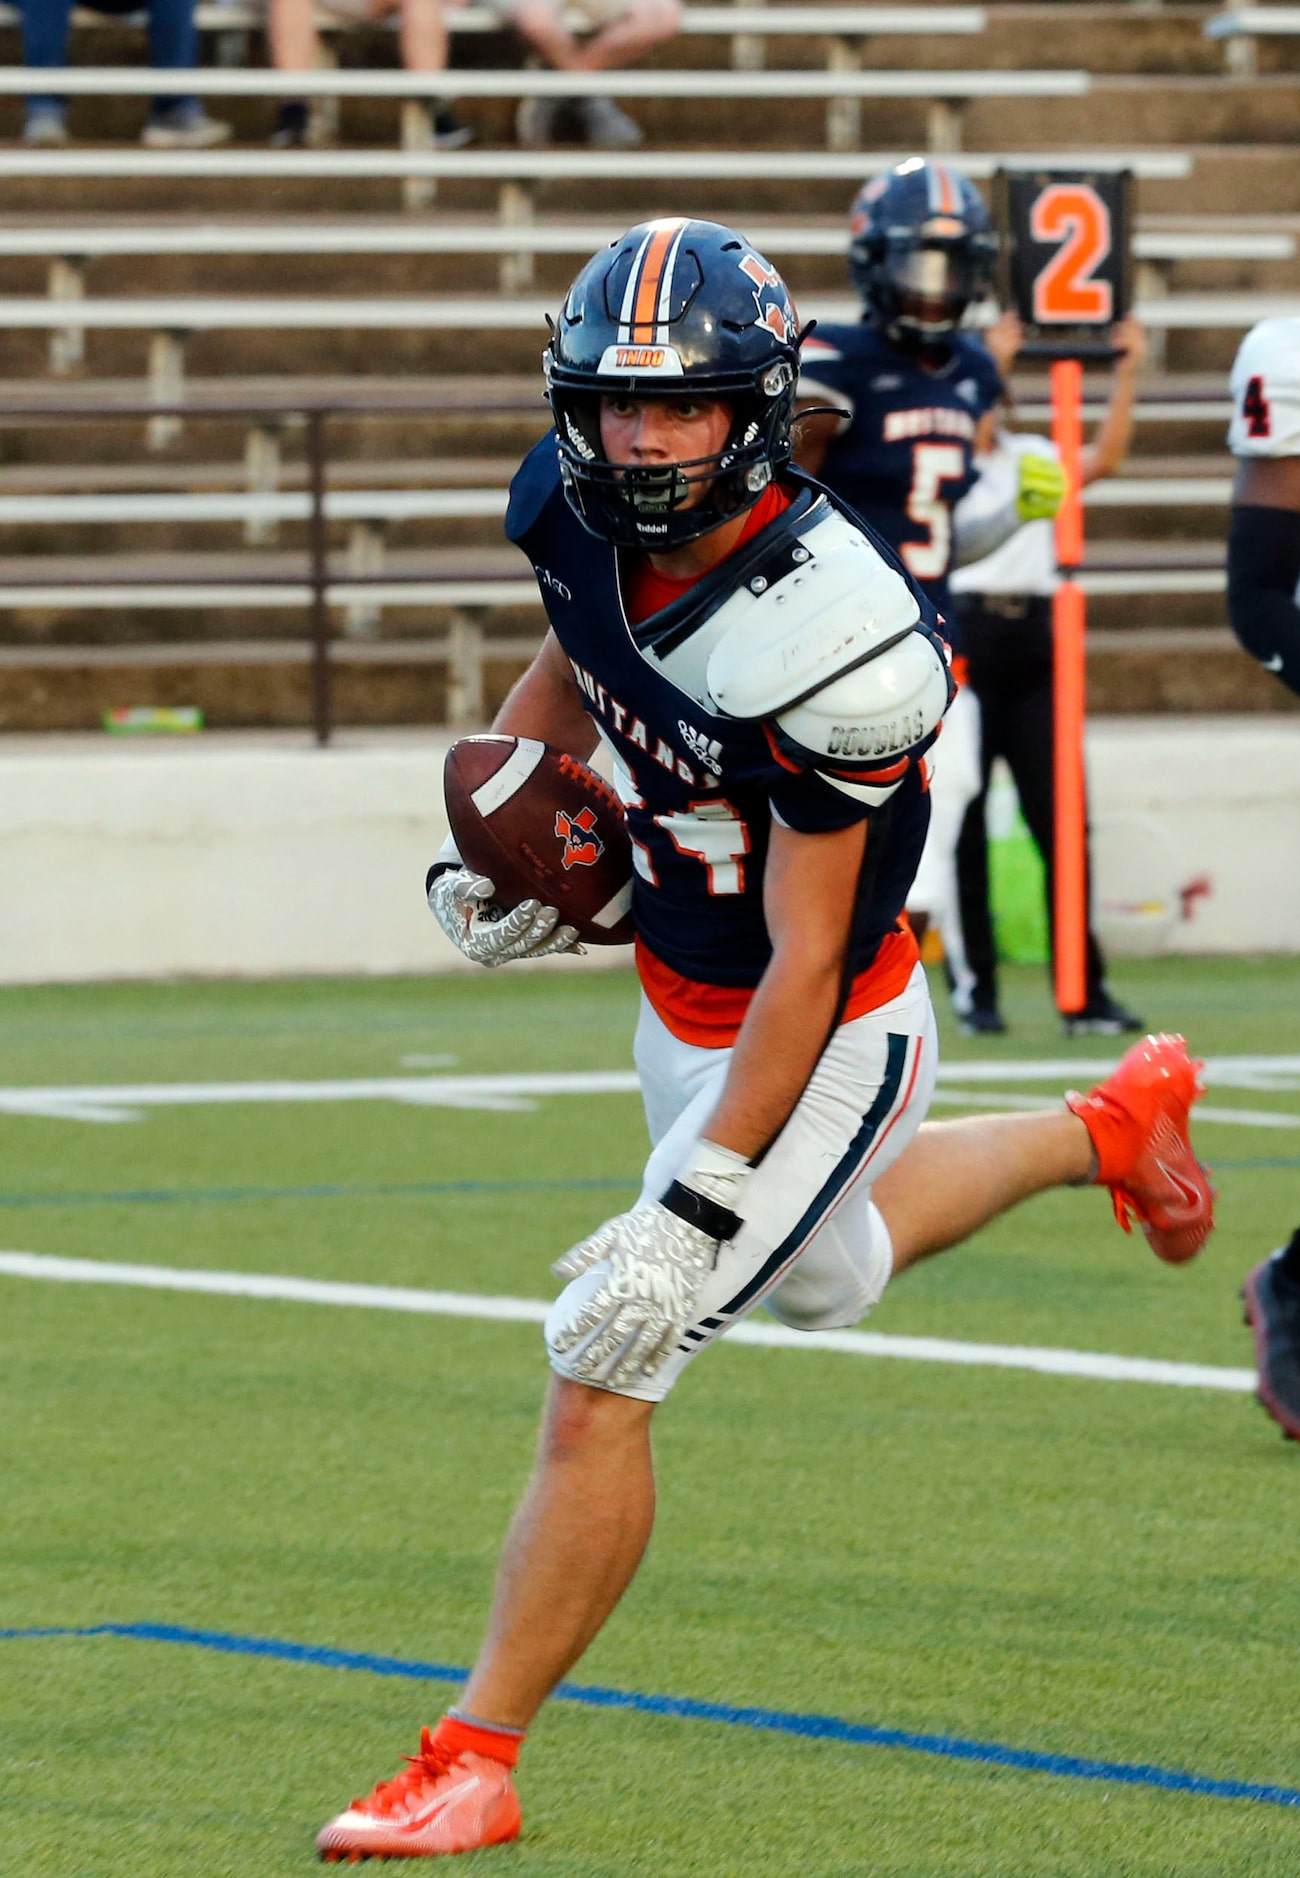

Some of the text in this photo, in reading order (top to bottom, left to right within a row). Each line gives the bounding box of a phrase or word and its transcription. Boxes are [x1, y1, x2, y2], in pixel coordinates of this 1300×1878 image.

[1030, 182, 1112, 323] 2
[1242, 375, 1271, 438] 4
[900, 440, 965, 581] 5
[677, 719, 723, 777] adidas
